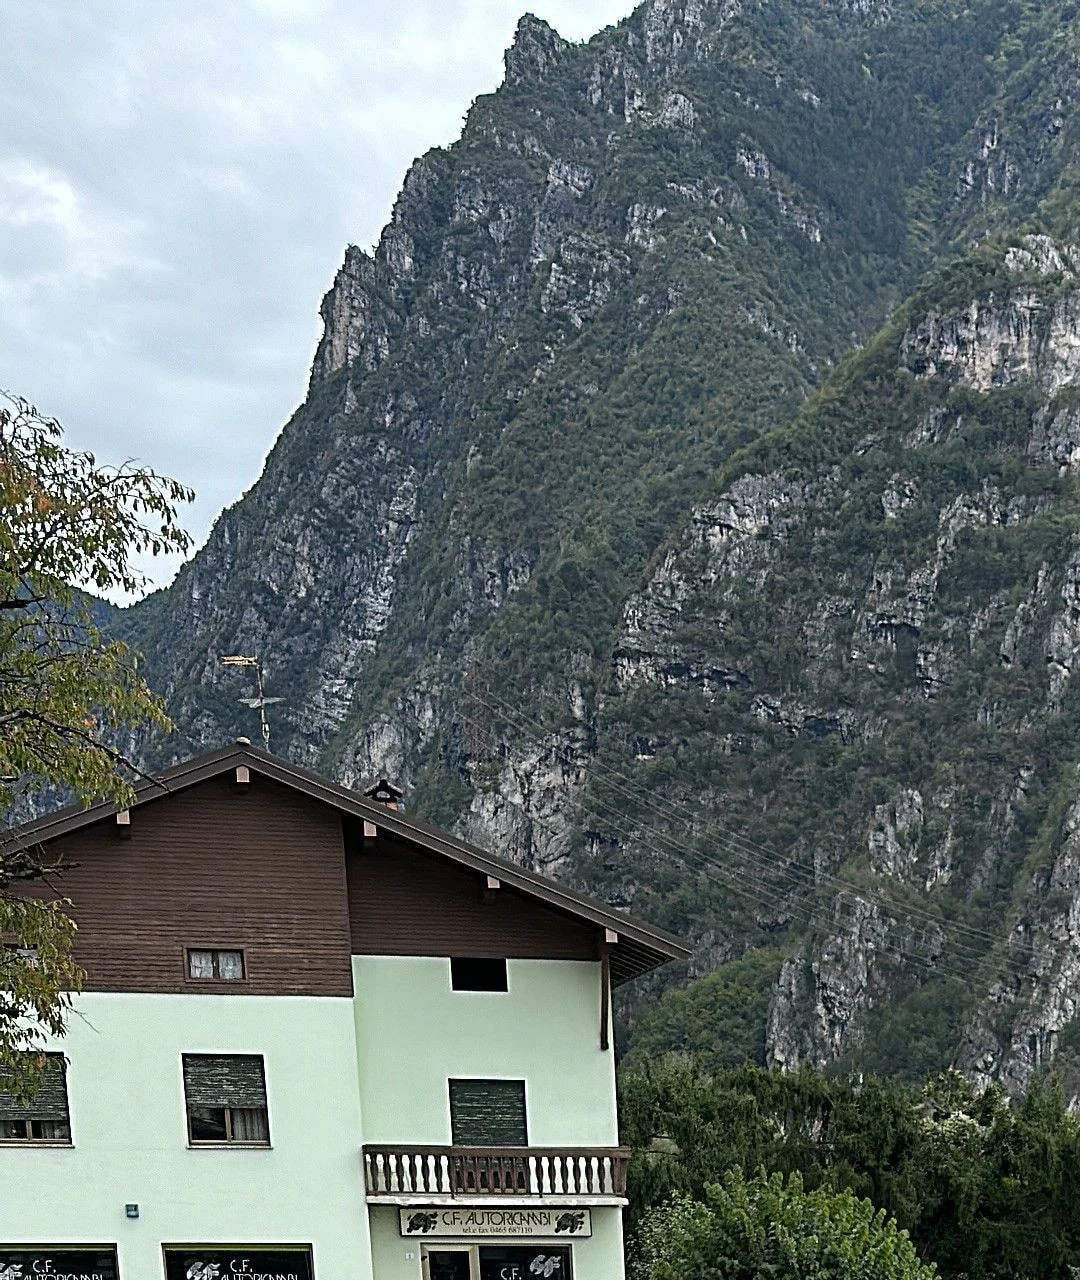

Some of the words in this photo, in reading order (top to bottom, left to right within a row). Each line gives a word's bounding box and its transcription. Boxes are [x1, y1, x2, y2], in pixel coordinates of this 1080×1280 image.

[442, 1211, 463, 1226] C.F.
[465, 1211, 551, 1226] AUTORICAMBI
[33, 1259, 57, 1273] C.F.
[230, 1259, 253, 1273] C.F.
[500, 1267, 522, 1280] C.F.
